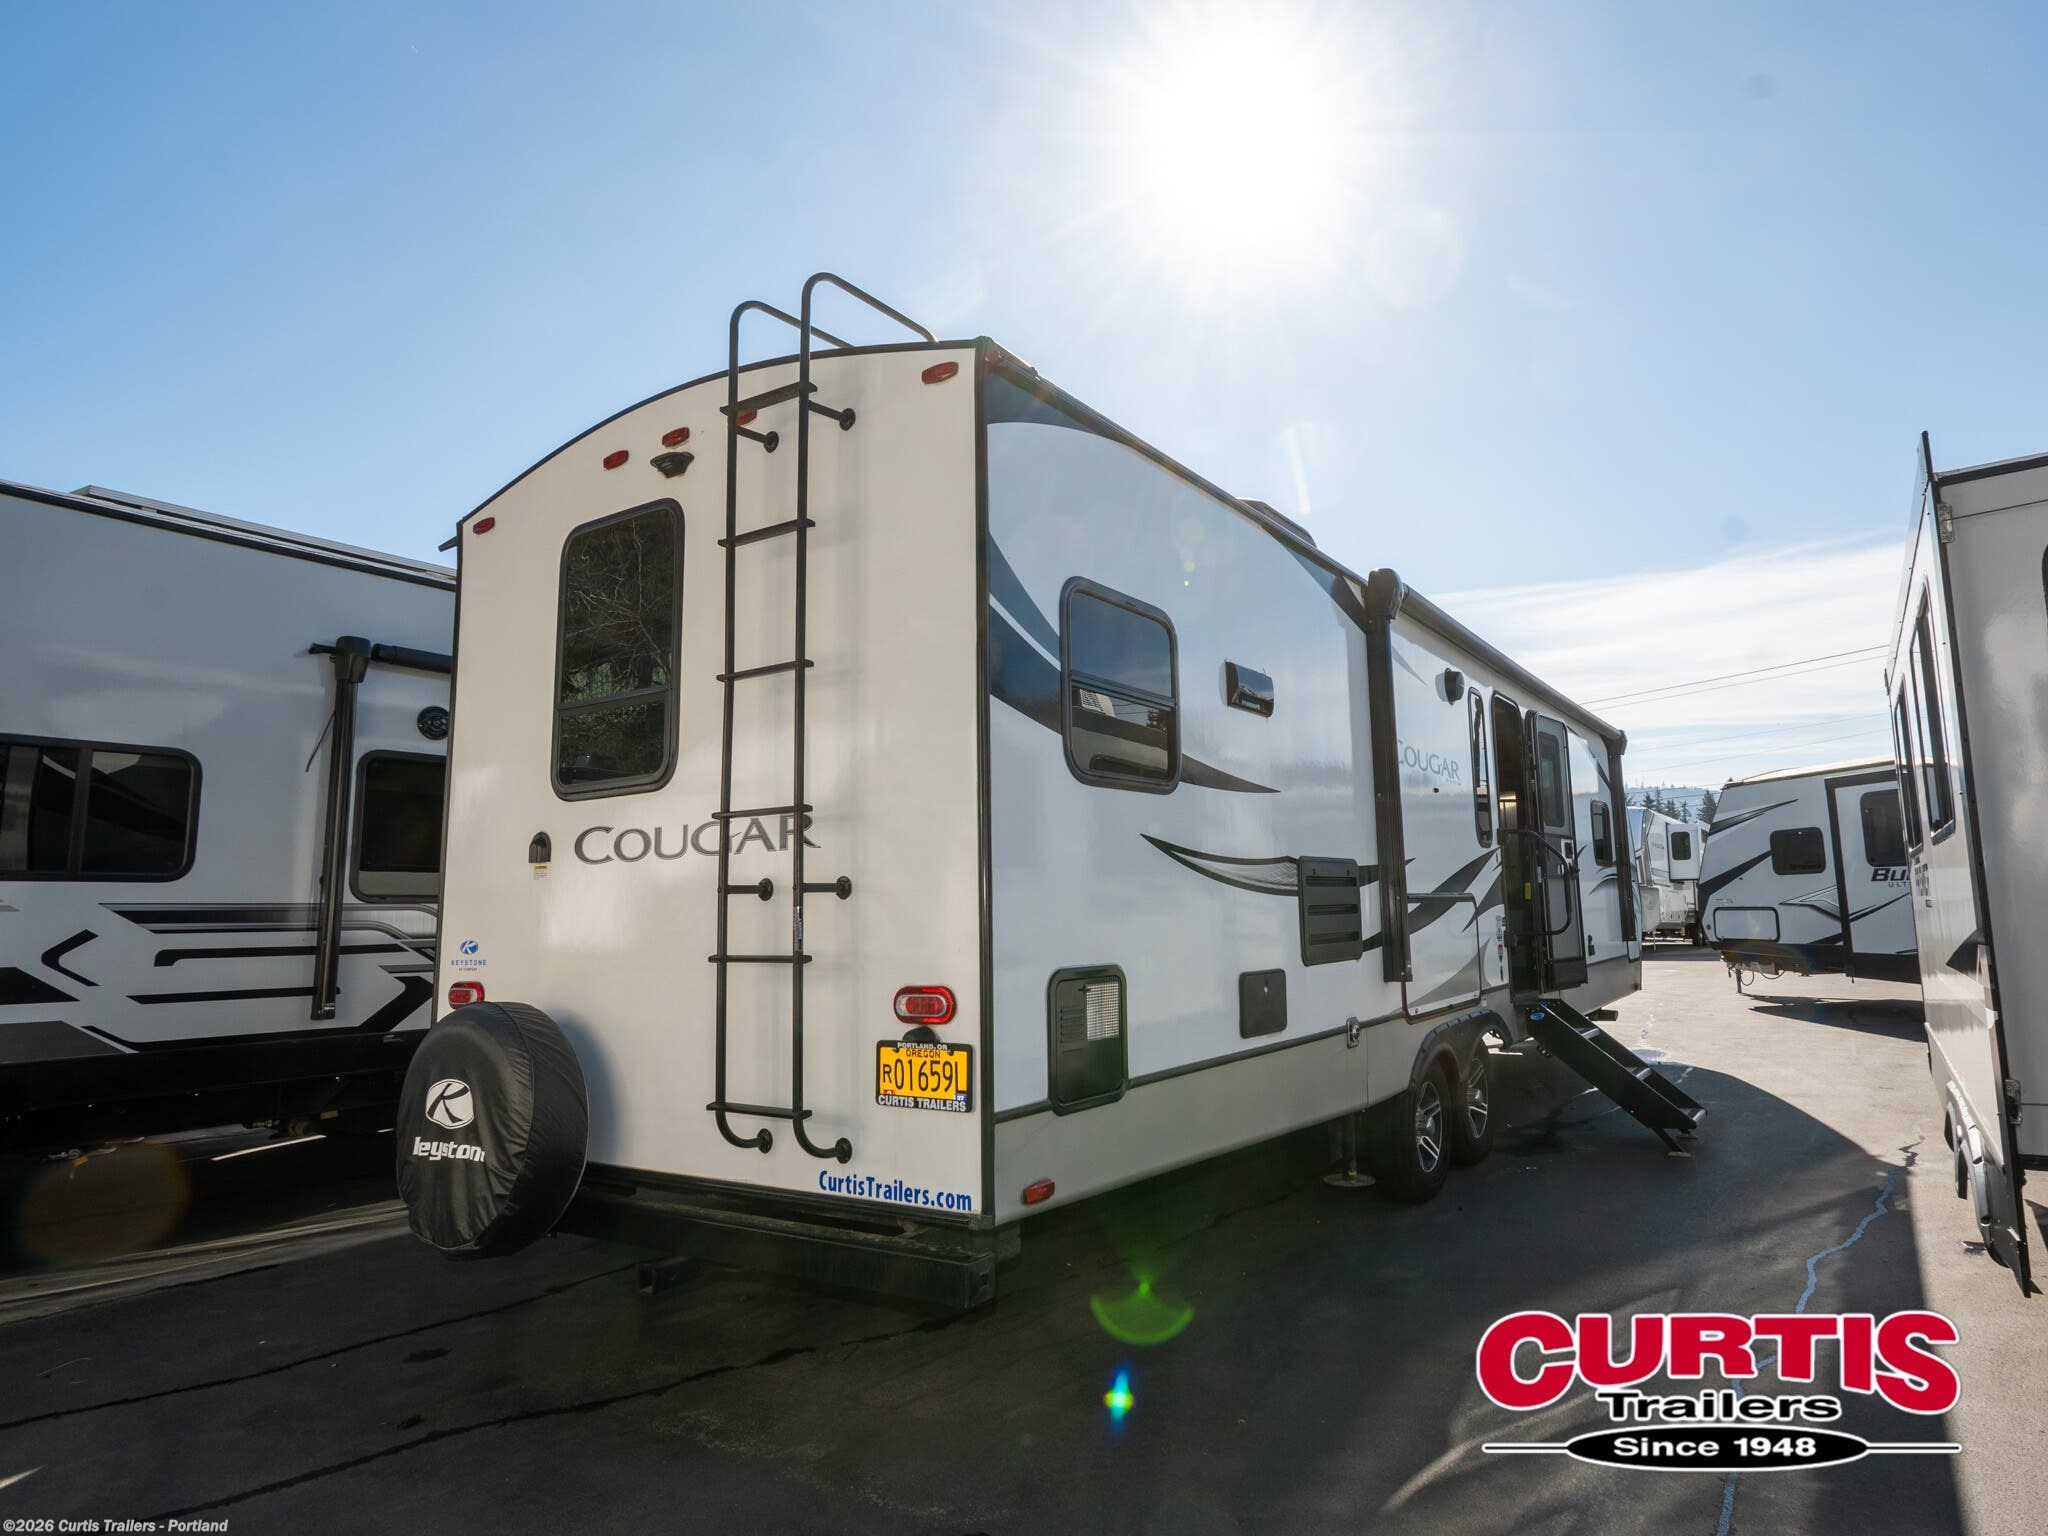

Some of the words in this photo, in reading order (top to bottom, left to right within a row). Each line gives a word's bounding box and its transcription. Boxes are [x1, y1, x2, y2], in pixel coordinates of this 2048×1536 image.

[574, 813, 822, 865] COUGAR
[1871, 867, 1910, 881] BU
[905, 1049, 941, 1058] OREGON
[882, 1058, 967, 1093] R01659L
[878, 1094, 915, 1108] CURTIS
[916, 1098, 967, 1112] TRAILERS
[819, 1170, 972, 1211] CurtisTrailers.com
